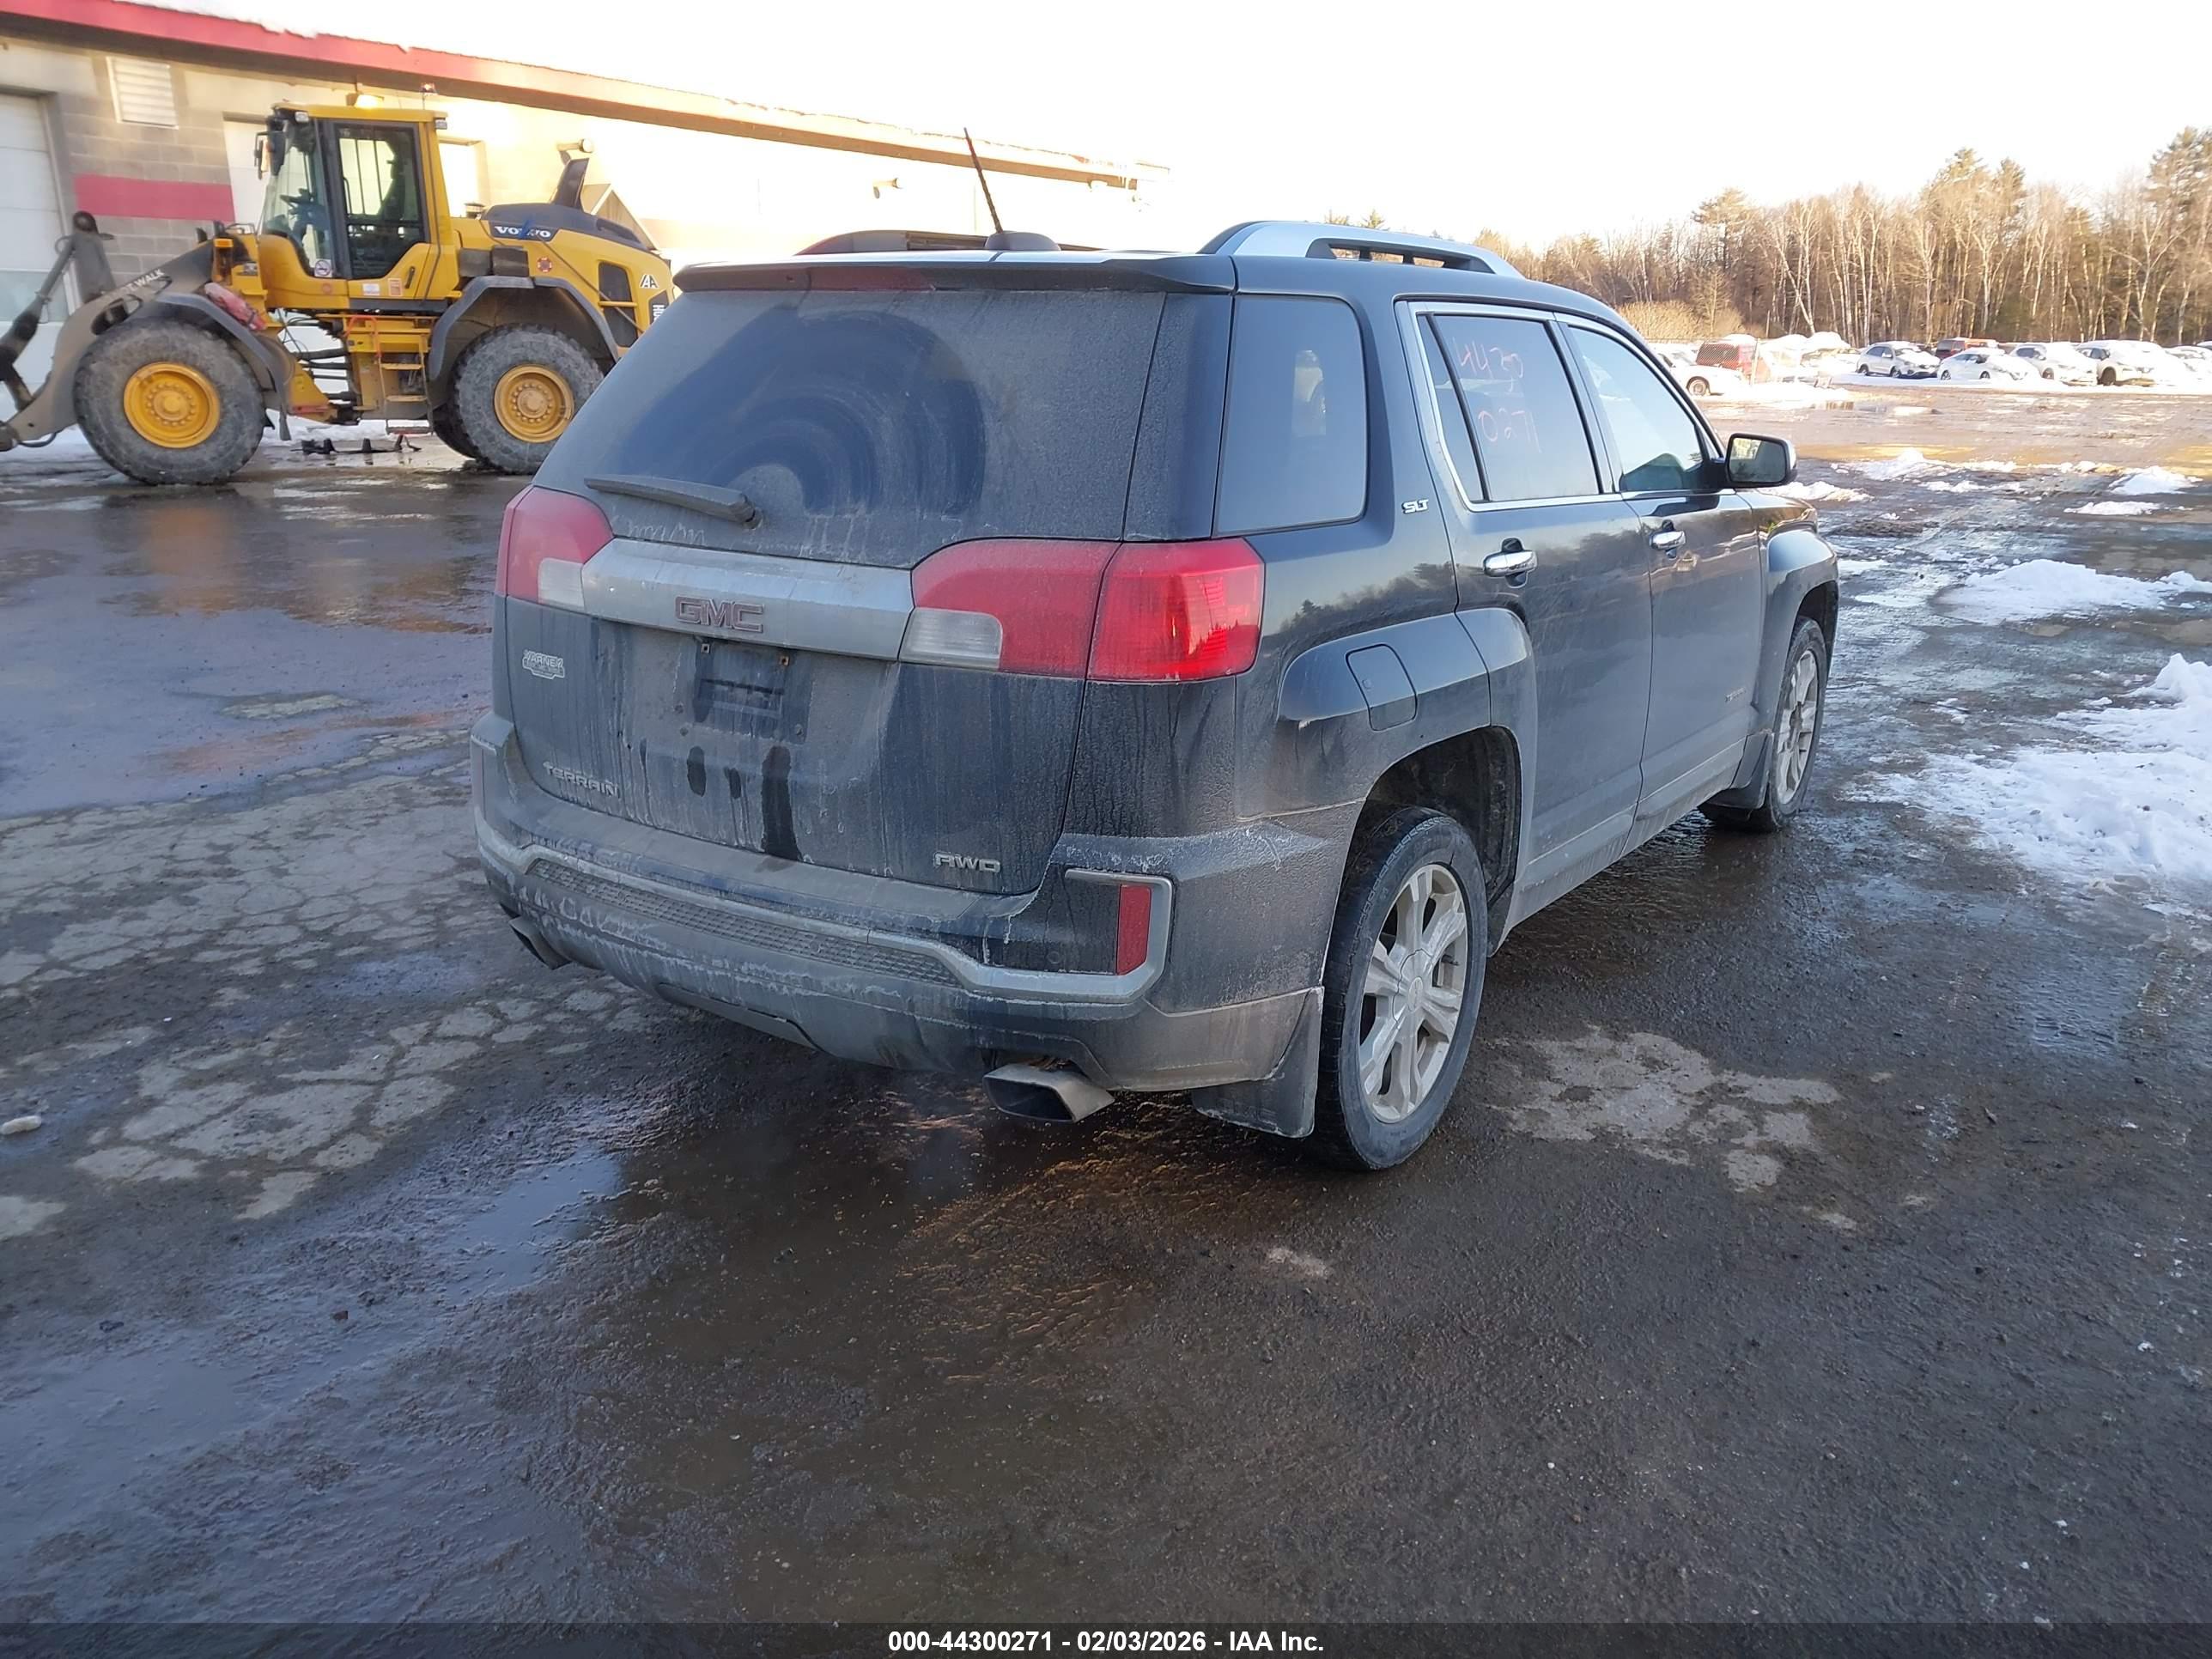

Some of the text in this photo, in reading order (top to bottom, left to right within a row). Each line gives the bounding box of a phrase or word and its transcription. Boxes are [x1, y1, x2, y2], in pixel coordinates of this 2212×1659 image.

[134, 268, 165, 287] WALK
[1402, 499, 1429, 514] SLT
[675, 595, 764, 633] GMC
[543, 762, 619, 798] TERRAIN
[933, 852, 1001, 873] AWD
